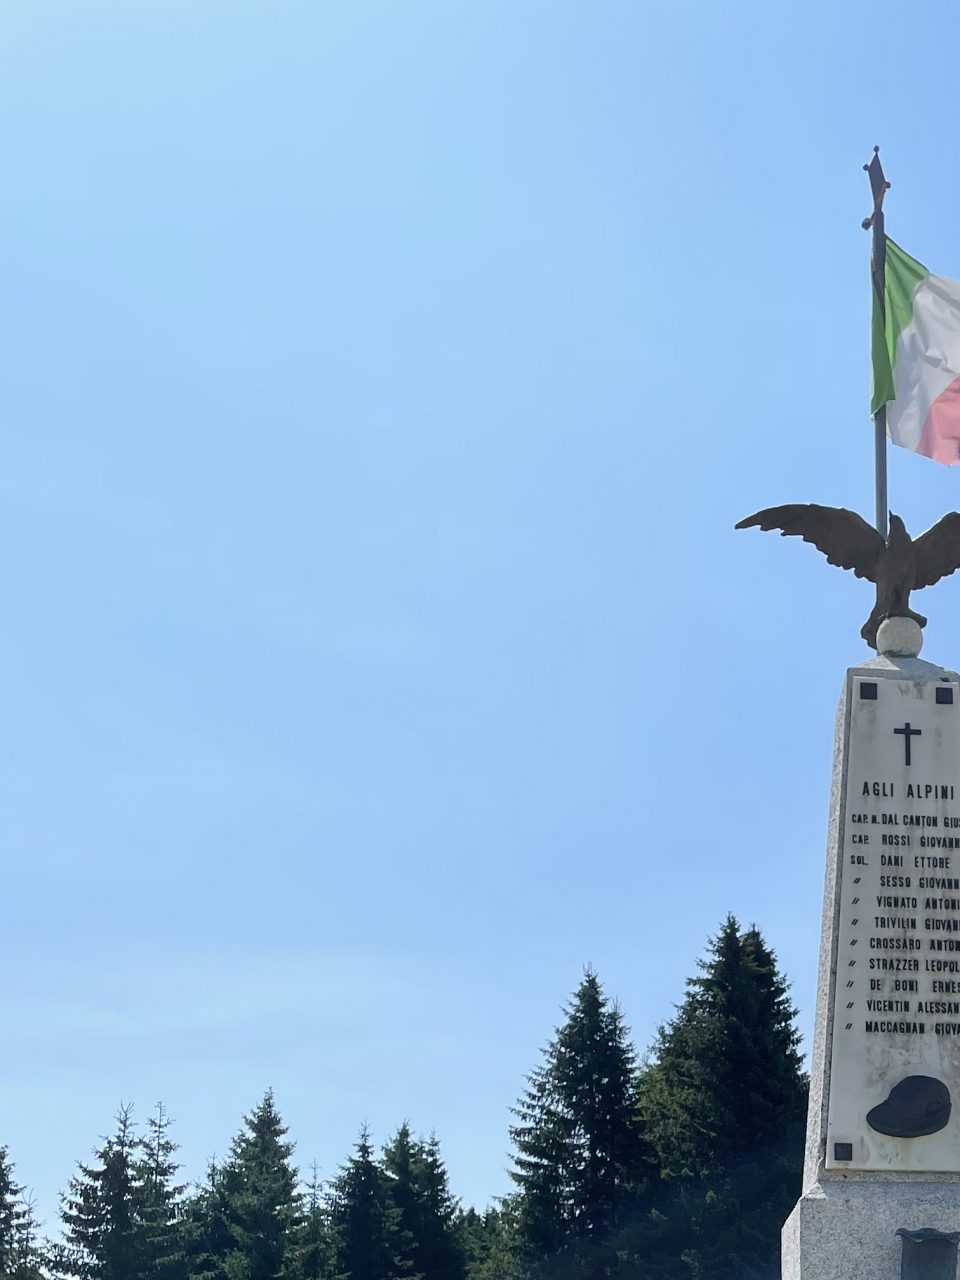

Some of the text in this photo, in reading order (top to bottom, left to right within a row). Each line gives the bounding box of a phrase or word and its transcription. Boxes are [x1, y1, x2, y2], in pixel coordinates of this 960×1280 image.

[862, 782, 954, 800] AGLI ALPINI
[852, 814, 868, 823] CAP.
[882, 814, 898, 825] DAL
[903, 815, 938, 827] CANTON
[882, 835, 910, 846] ROSSI
[851, 855, 950, 868] SOL. DANI ETTORE
[880, 876, 911, 887] SESSO
[877, 896, 917, 908] VIGNATO
[875, 917, 916, 929] TRIVILIN
[870, 938, 921, 950] CROSSARO
[870, 959, 919, 971] STRAZZER
[871, 980, 881, 990] DE
[895, 980, 918, 992] BONI
[867, 1000, 909, 1012] VICENTIN
[865, 1022, 924, 1034] MACCAGNAN
